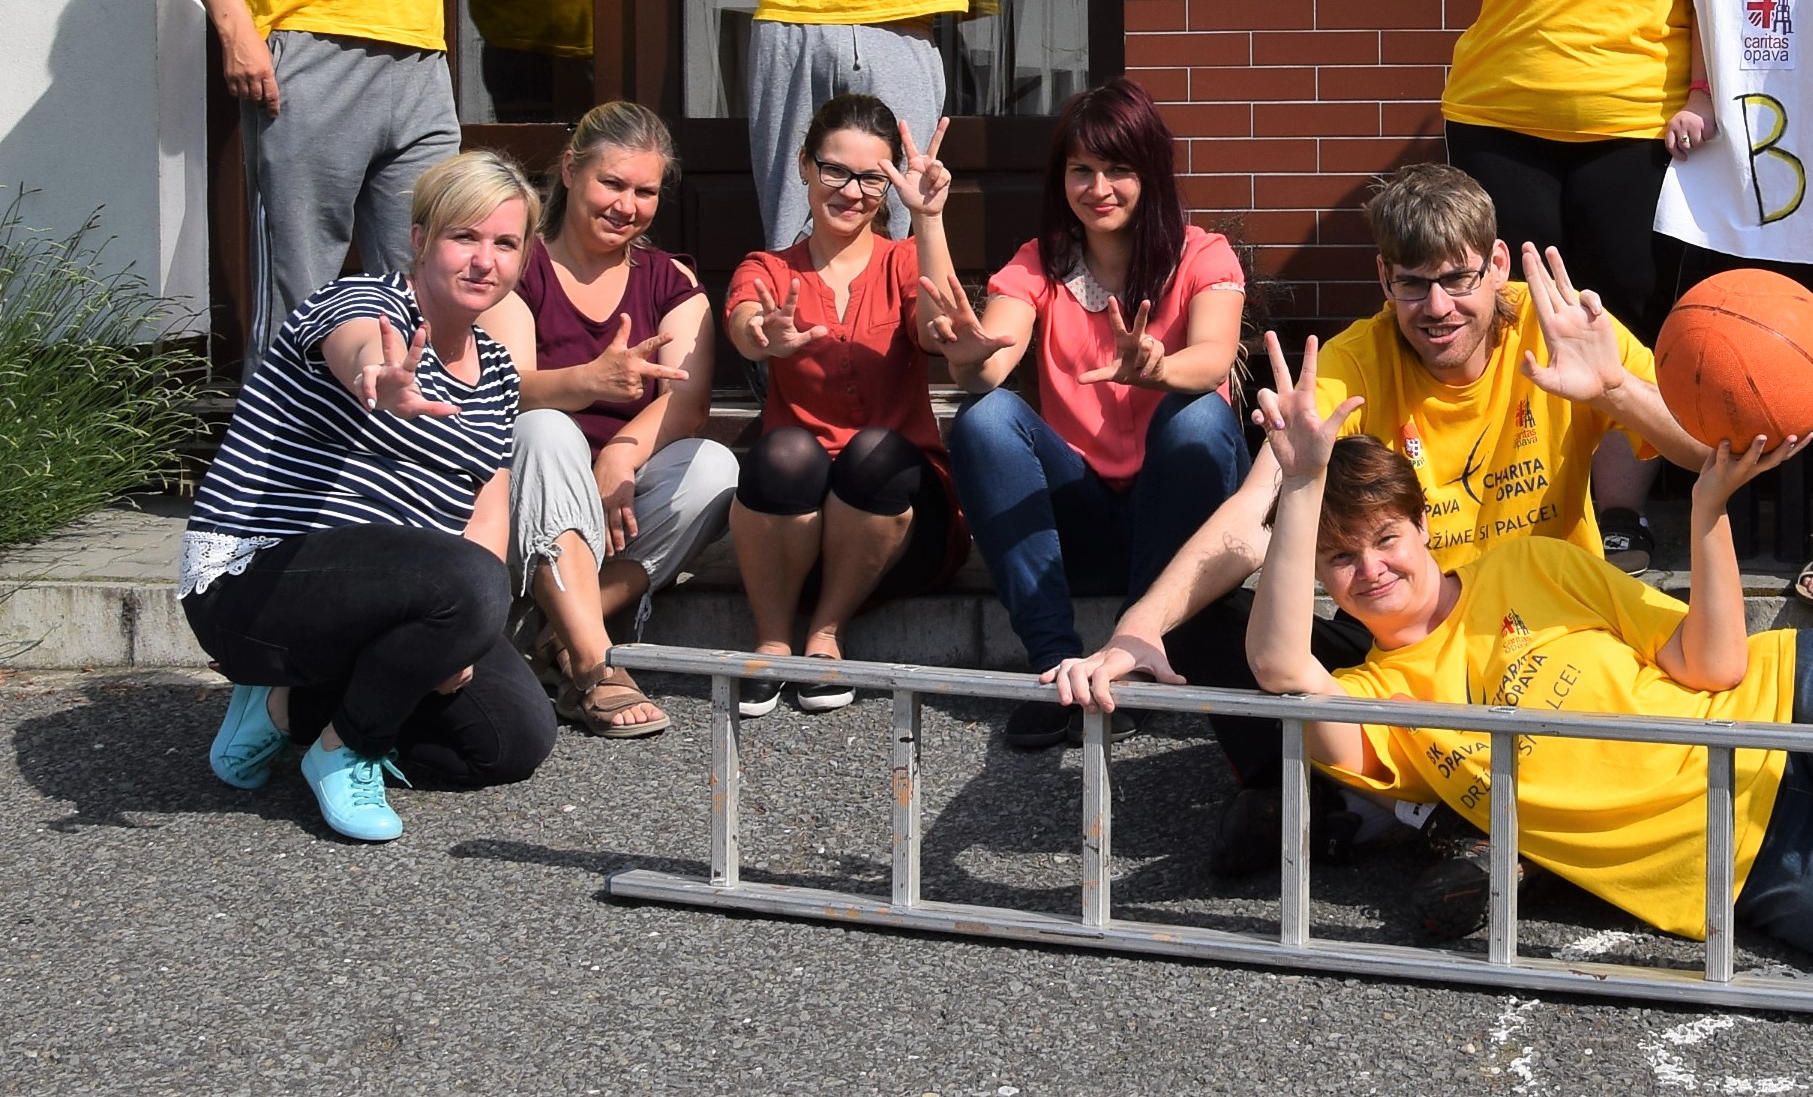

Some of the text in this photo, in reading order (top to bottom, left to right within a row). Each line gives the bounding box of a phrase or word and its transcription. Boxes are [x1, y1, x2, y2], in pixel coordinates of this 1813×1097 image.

[1743, 49, 1790, 64] opava
[1744, 34, 1790, 50] caritas
[1483, 457, 1545, 489] CHARITA
[1496, 474, 1549, 502] OPAVA
[1425, 499, 1460, 518] PAVA
[1479, 526, 1489, 541] SI
[1494, 503, 1559, 537] PALCE!
[1504, 654, 1548, 707] OPAVA
[1546, 663, 1582, 710] LCE!
[1426, 741, 1444, 765] BK
[1438, 741, 1490, 779] OPAVA
